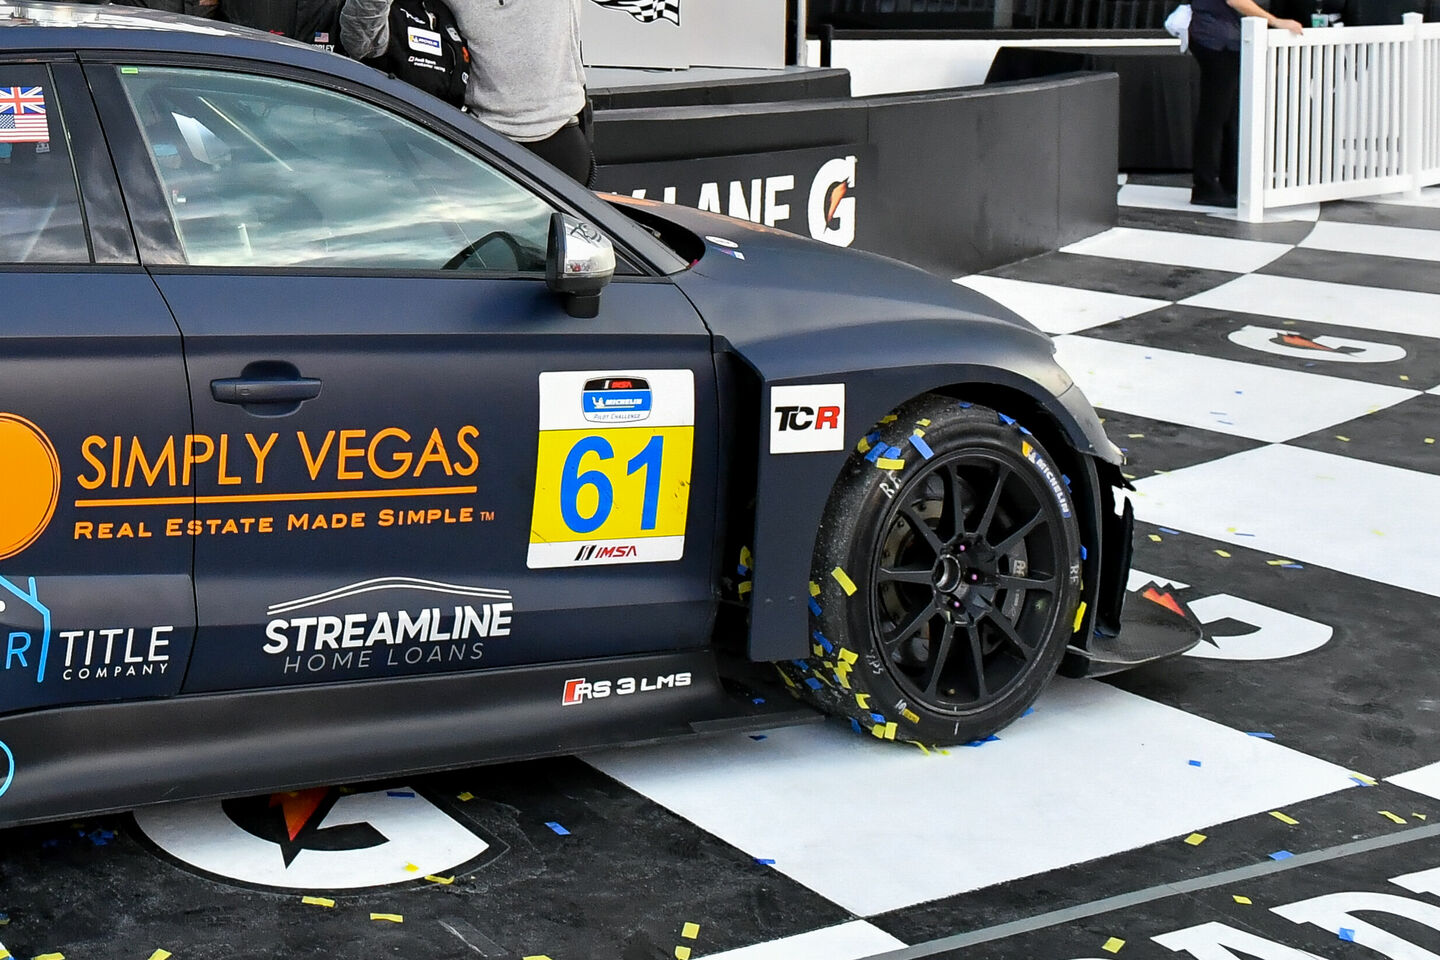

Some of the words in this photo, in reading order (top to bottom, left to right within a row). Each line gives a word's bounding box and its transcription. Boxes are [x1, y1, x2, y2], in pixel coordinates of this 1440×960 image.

[775, 404, 840, 432] TCR
[77, 432, 279, 490] SIMPLY
[304, 426, 480, 481] VEGAS
[560, 436, 664, 534] 61
[1037, 458, 1069, 514] MICHELIN
[595, 546, 637, 558] IMSA
[60, 626, 173, 666] TITLE
[263, 603, 513, 655] STREAMLINE
[62, 663, 169, 681] COMPANY
[284, 649, 371, 674] HOME
[387, 643, 484, 666] LOANS
[574, 680, 611, 700] RS
[616, 677, 636, 695] 3
[640, 672, 692, 691] LMS
